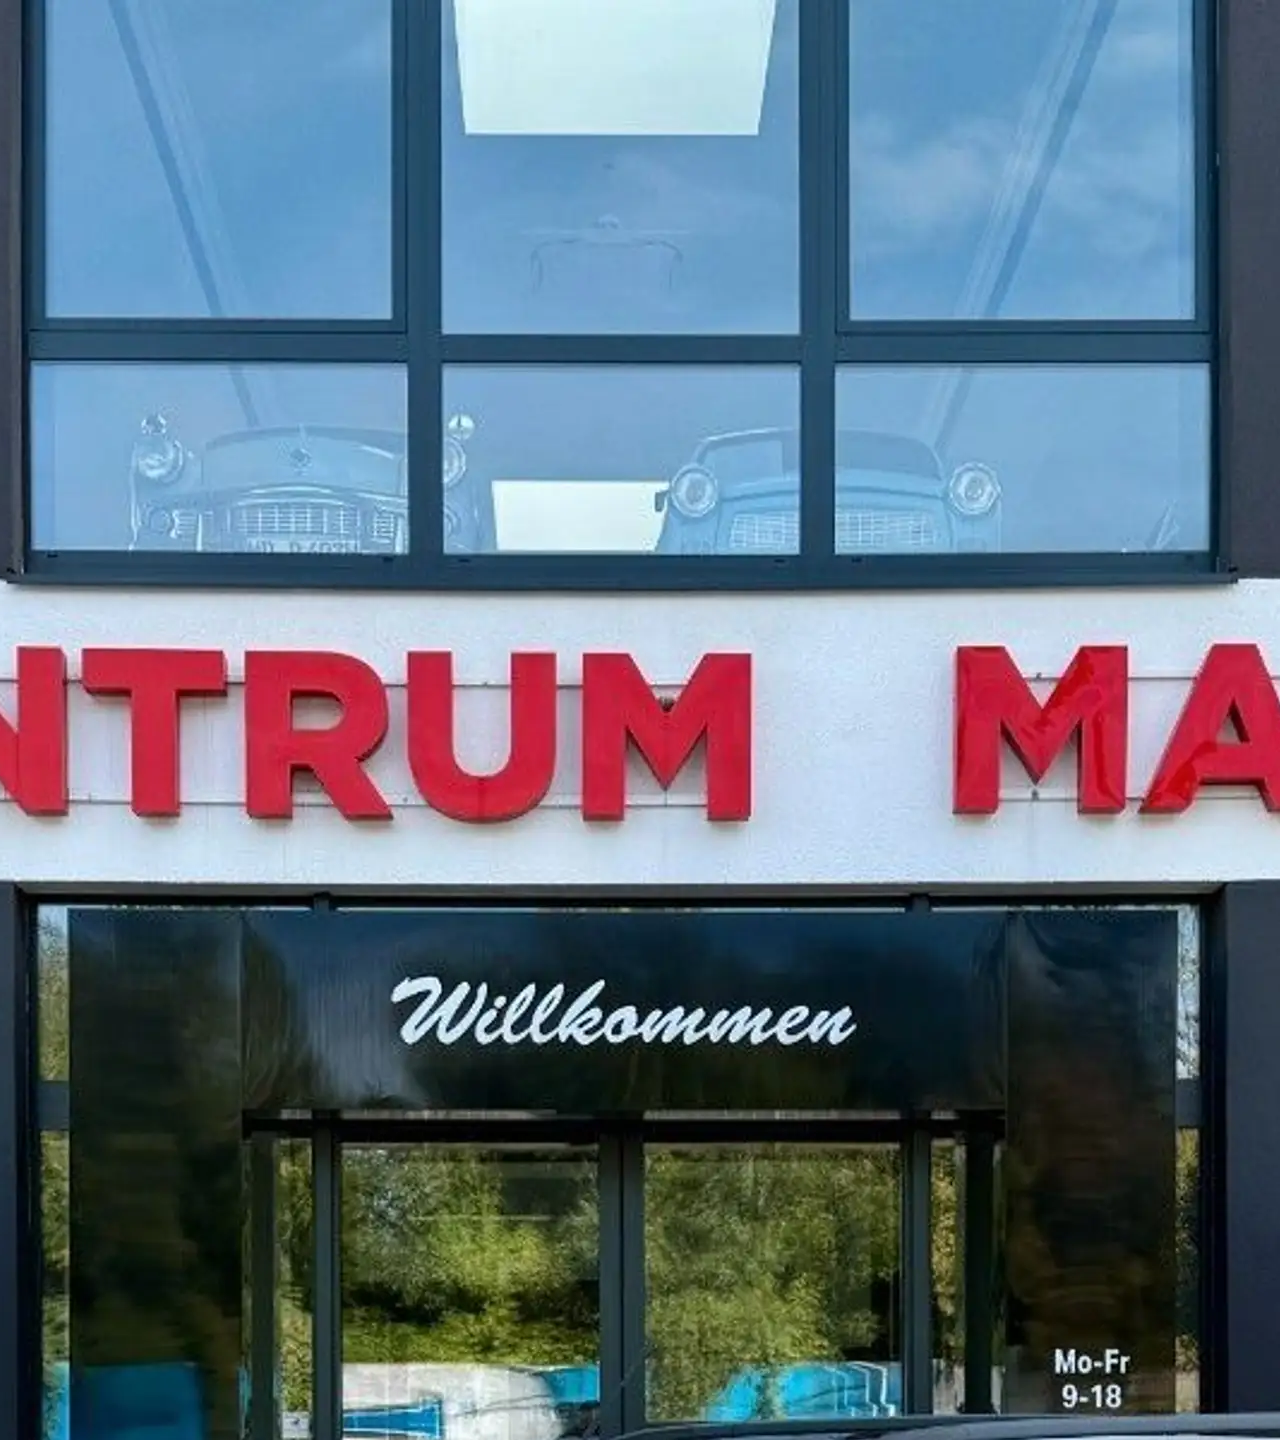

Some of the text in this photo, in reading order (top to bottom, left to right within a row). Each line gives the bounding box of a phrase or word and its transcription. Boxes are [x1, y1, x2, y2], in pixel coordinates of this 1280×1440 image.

[391, 975, 856, 1046] Willkommen
[1055, 1348, 1131, 1374] Mo-Fr
[1061, 1384, 1122, 1408] 9-18
